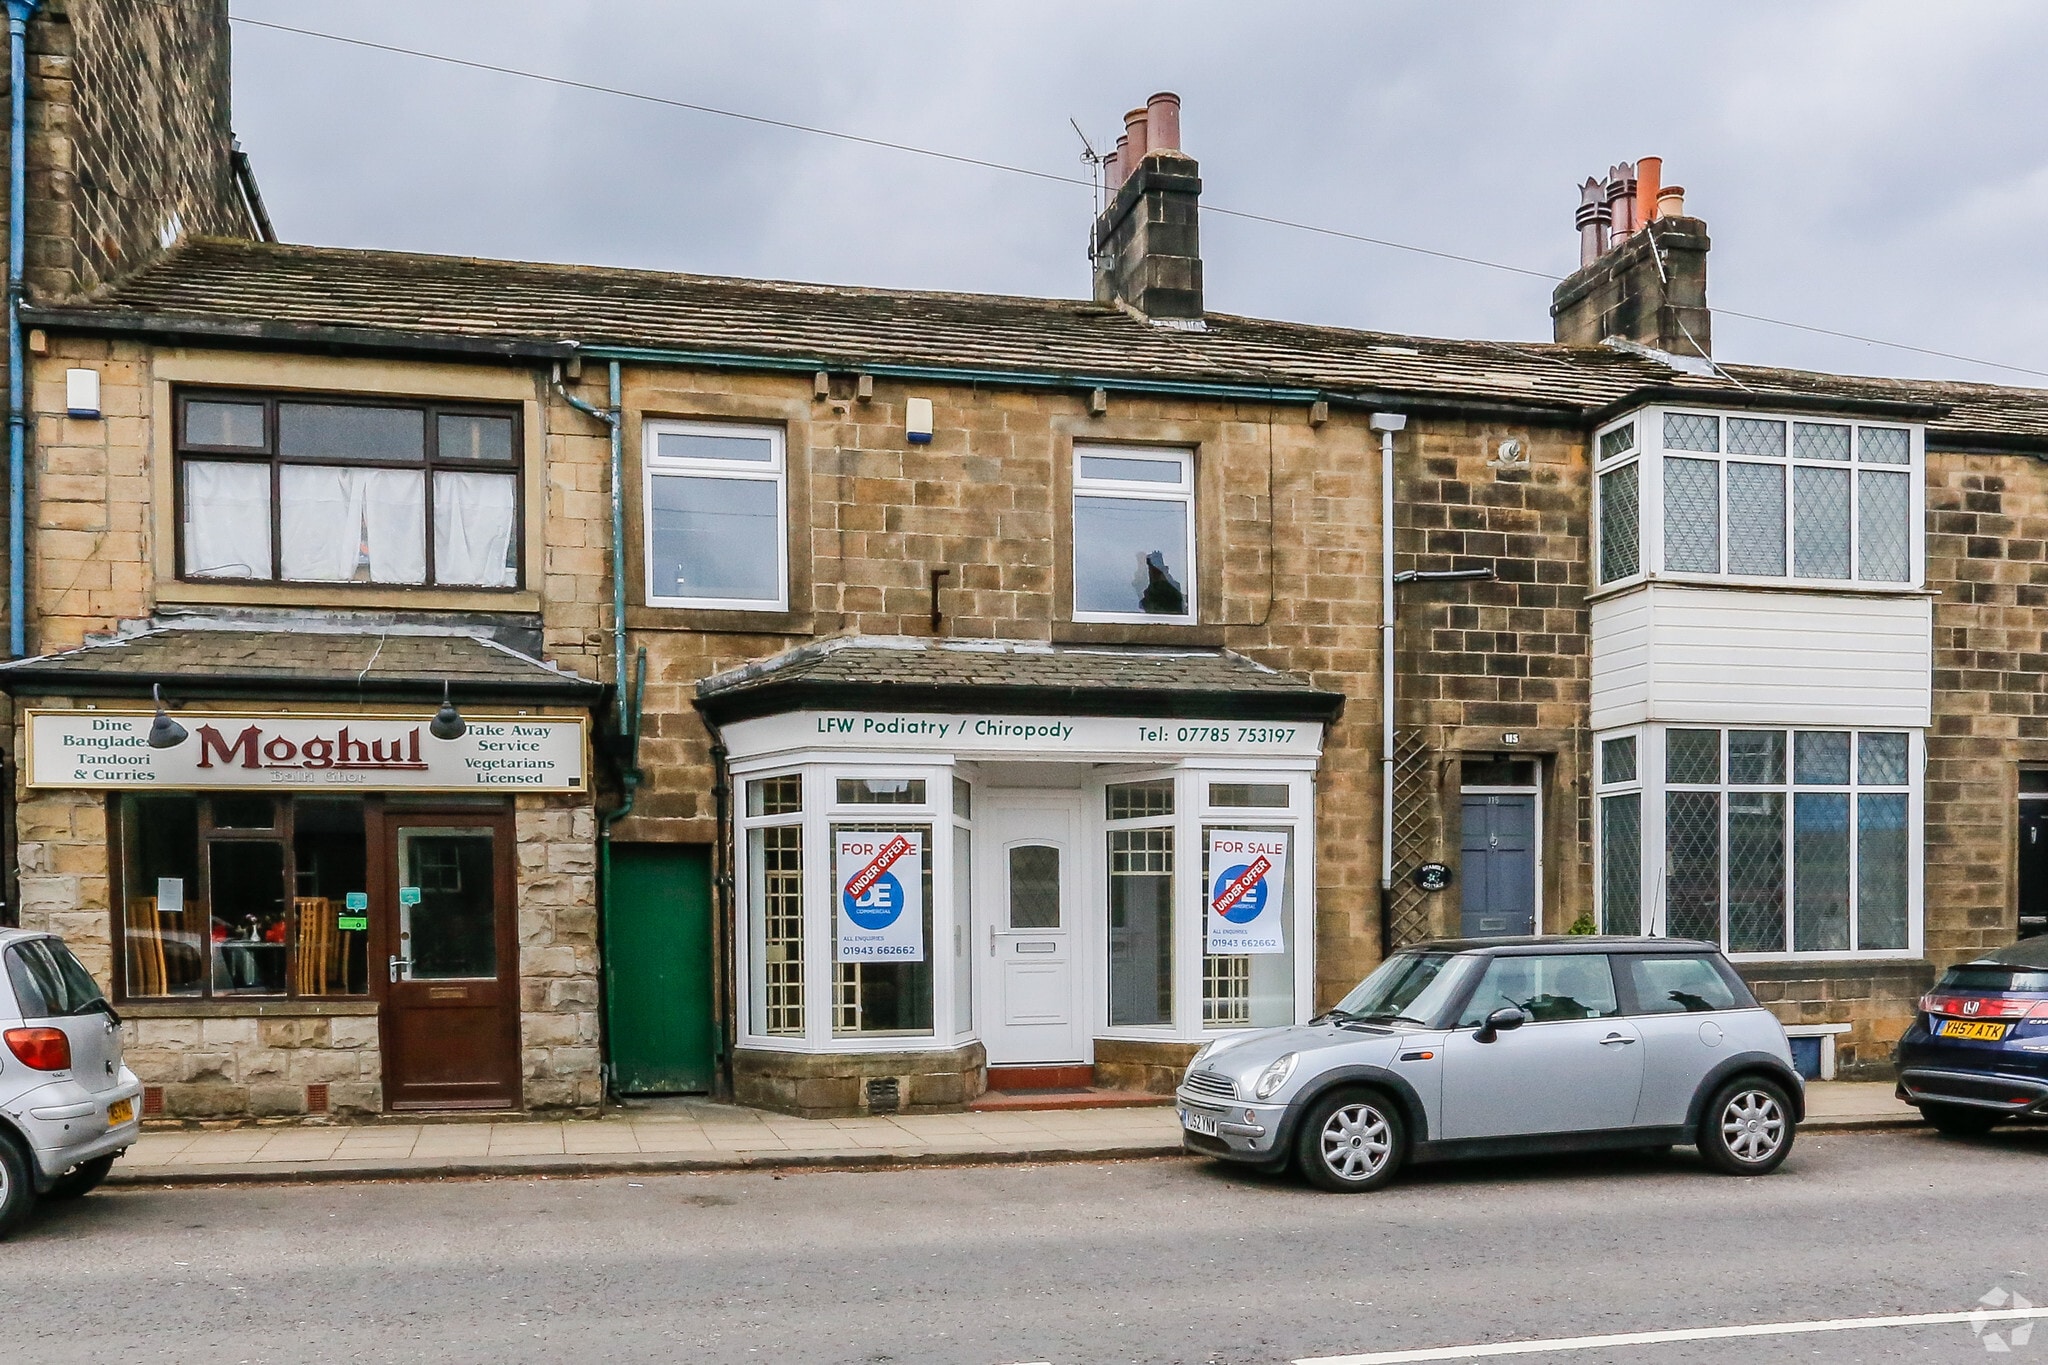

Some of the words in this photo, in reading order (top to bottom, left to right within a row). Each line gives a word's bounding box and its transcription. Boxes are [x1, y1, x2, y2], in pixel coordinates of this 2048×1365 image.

[92, 719, 132, 732] Dine
[466, 724, 505, 736] Take
[511, 725, 552, 739] Away
[817, 717, 855, 733] LFW
[864, 717, 950, 739] Podiatry
[957, 720, 967, 735] /
[975, 719, 1074, 742] Chiropody
[1139, 726, 1169, 742] Tel:
[1177, 727, 1230, 742] 07785
[1237, 728, 1296, 743] 753197
[63, 735, 151, 749] Banglades
[1505, 733, 1519, 744] 115
[195, 723, 424, 769] Moghul
[478, 740, 540, 752] Service
[77, 753, 150, 765] Tandoori
[464, 757, 555, 770] Vegetarians
[73, 769, 88, 781] &
[93, 768, 155, 781] Curries
[476, 773, 543, 784] Licensed
[842, 843, 874, 856] FOR
[1214, 841, 1243, 853] FOR
[1248, 842, 1283, 855] SALE
[849, 864, 881, 896] UNDER
[877, 839, 906, 868] OFFER
[1216, 882, 1244, 911] UNDER
[1242, 859, 1267, 886] OFFER
[855, 883, 892, 907] DE
[1212, 938, 1238, 947] 01943
[1242, 939, 1277, 947] 662662
[843, 946, 874, 955] 01943
[877, 946, 915, 955] 662662
[1946, 1021, 1975, 1035] YH57
[1975, 1024, 2003, 1038] ATK
